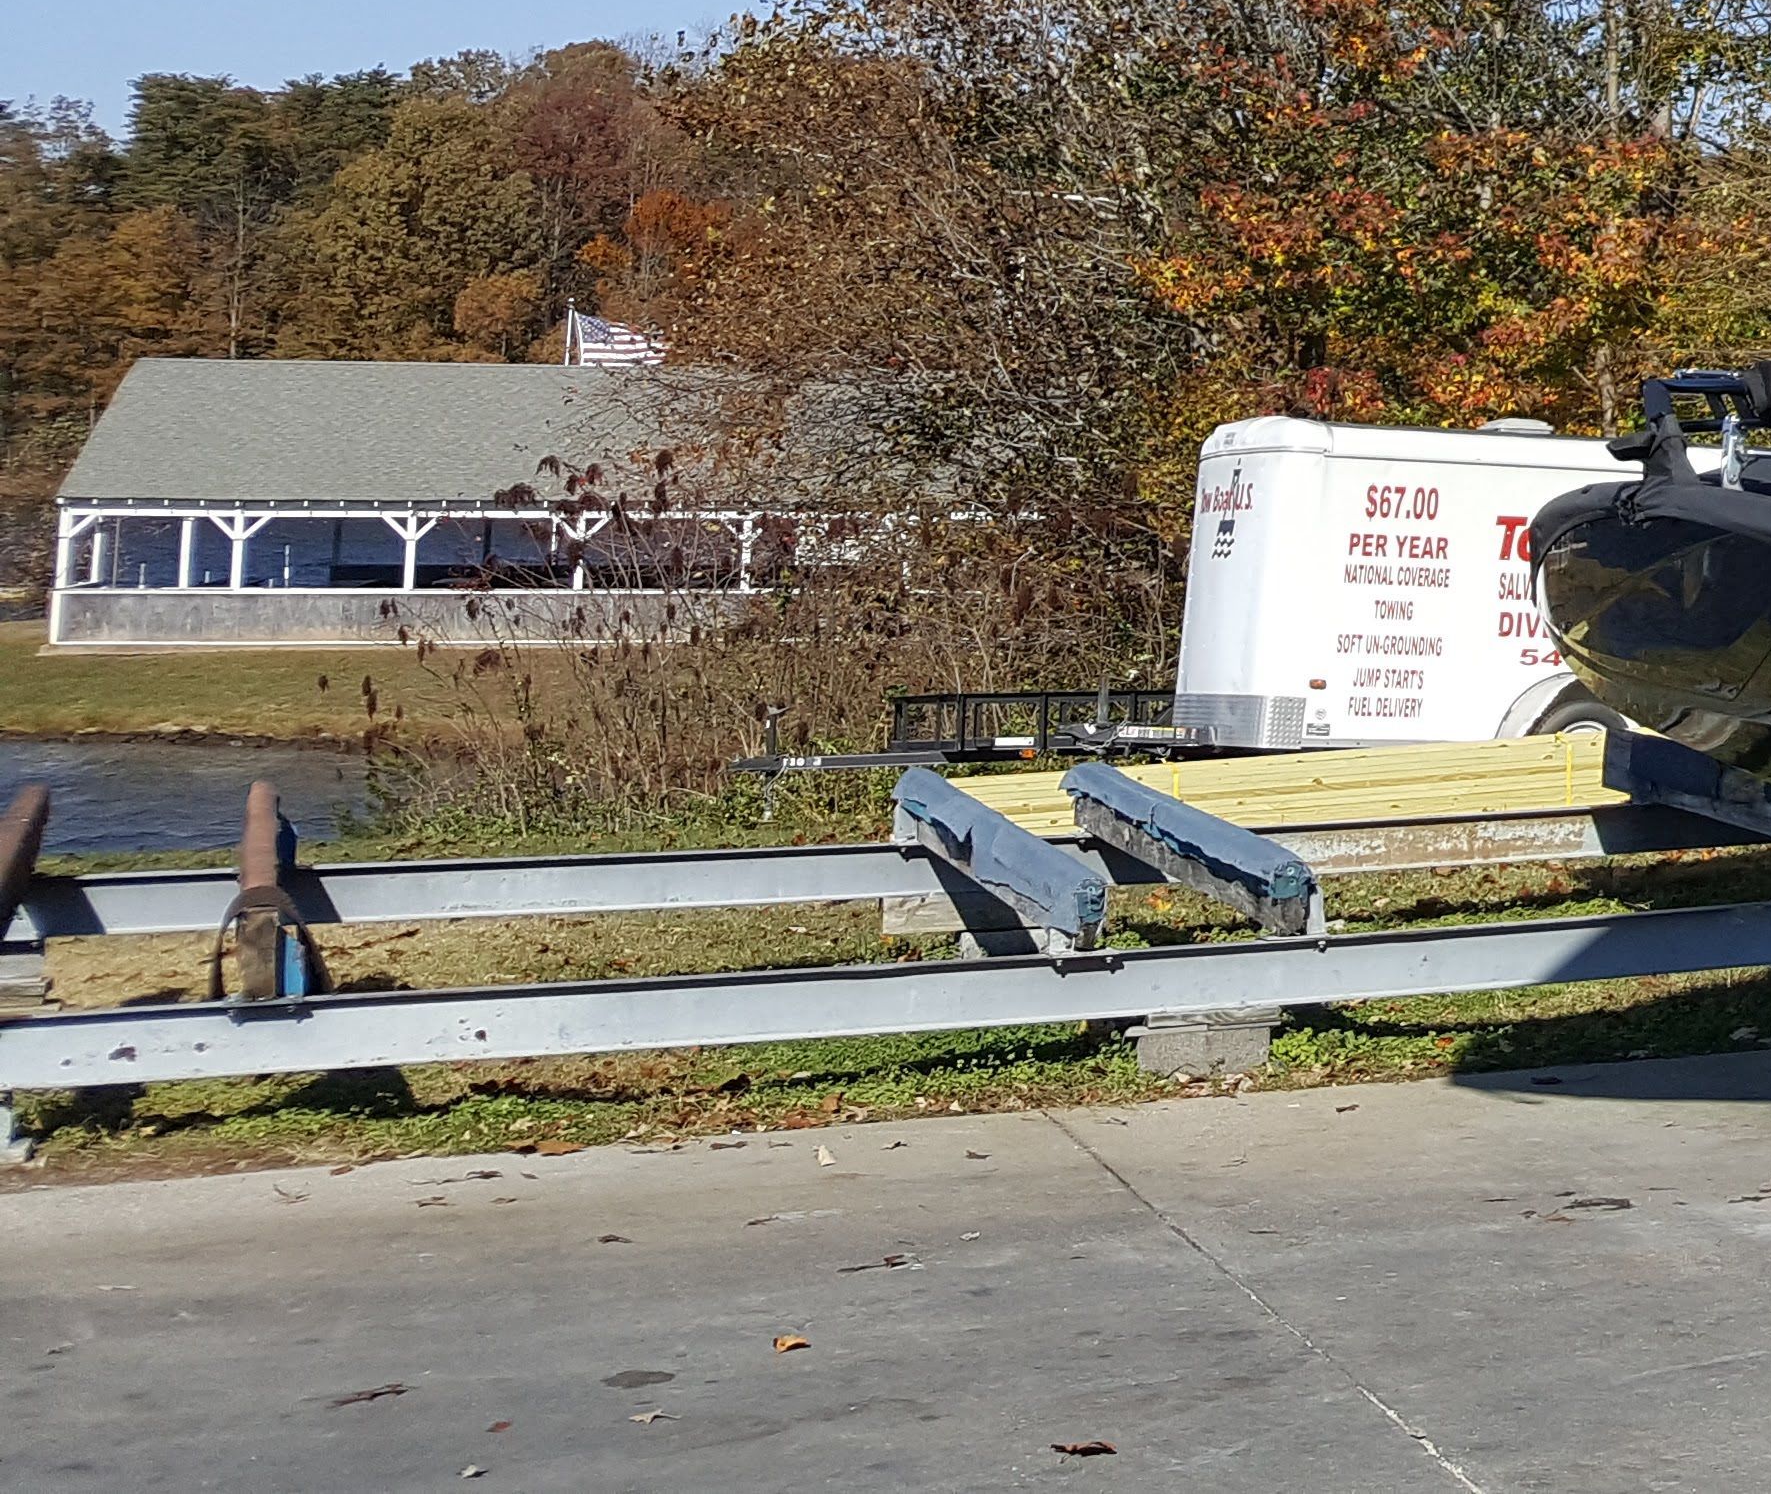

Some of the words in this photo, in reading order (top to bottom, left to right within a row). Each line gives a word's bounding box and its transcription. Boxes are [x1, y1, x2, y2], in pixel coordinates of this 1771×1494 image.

[1365, 483, 1439, 521] $67.00
[1348, 532, 1388, 557] PER
[1396, 534, 1449, 560] YEAR
[1344, 564, 1393, 585] NATIONAL
[1397, 566, 1451, 588] COVERAGE
[1499, 572, 1533, 601] SALV
[1375, 600, 1414, 621] TOWING
[1498, 612, 1550, 638] DIV
[1337, 634, 1363, 654] SOFT
[1366, 634, 1442, 657] UN-GROUNDING
[1353, 668, 1381, 688] JUMP
[1384, 668, 1424, 690] START'S
[1348, 696, 1372, 717] FUEL
[1376, 697, 1423, 718] DELIVERY
